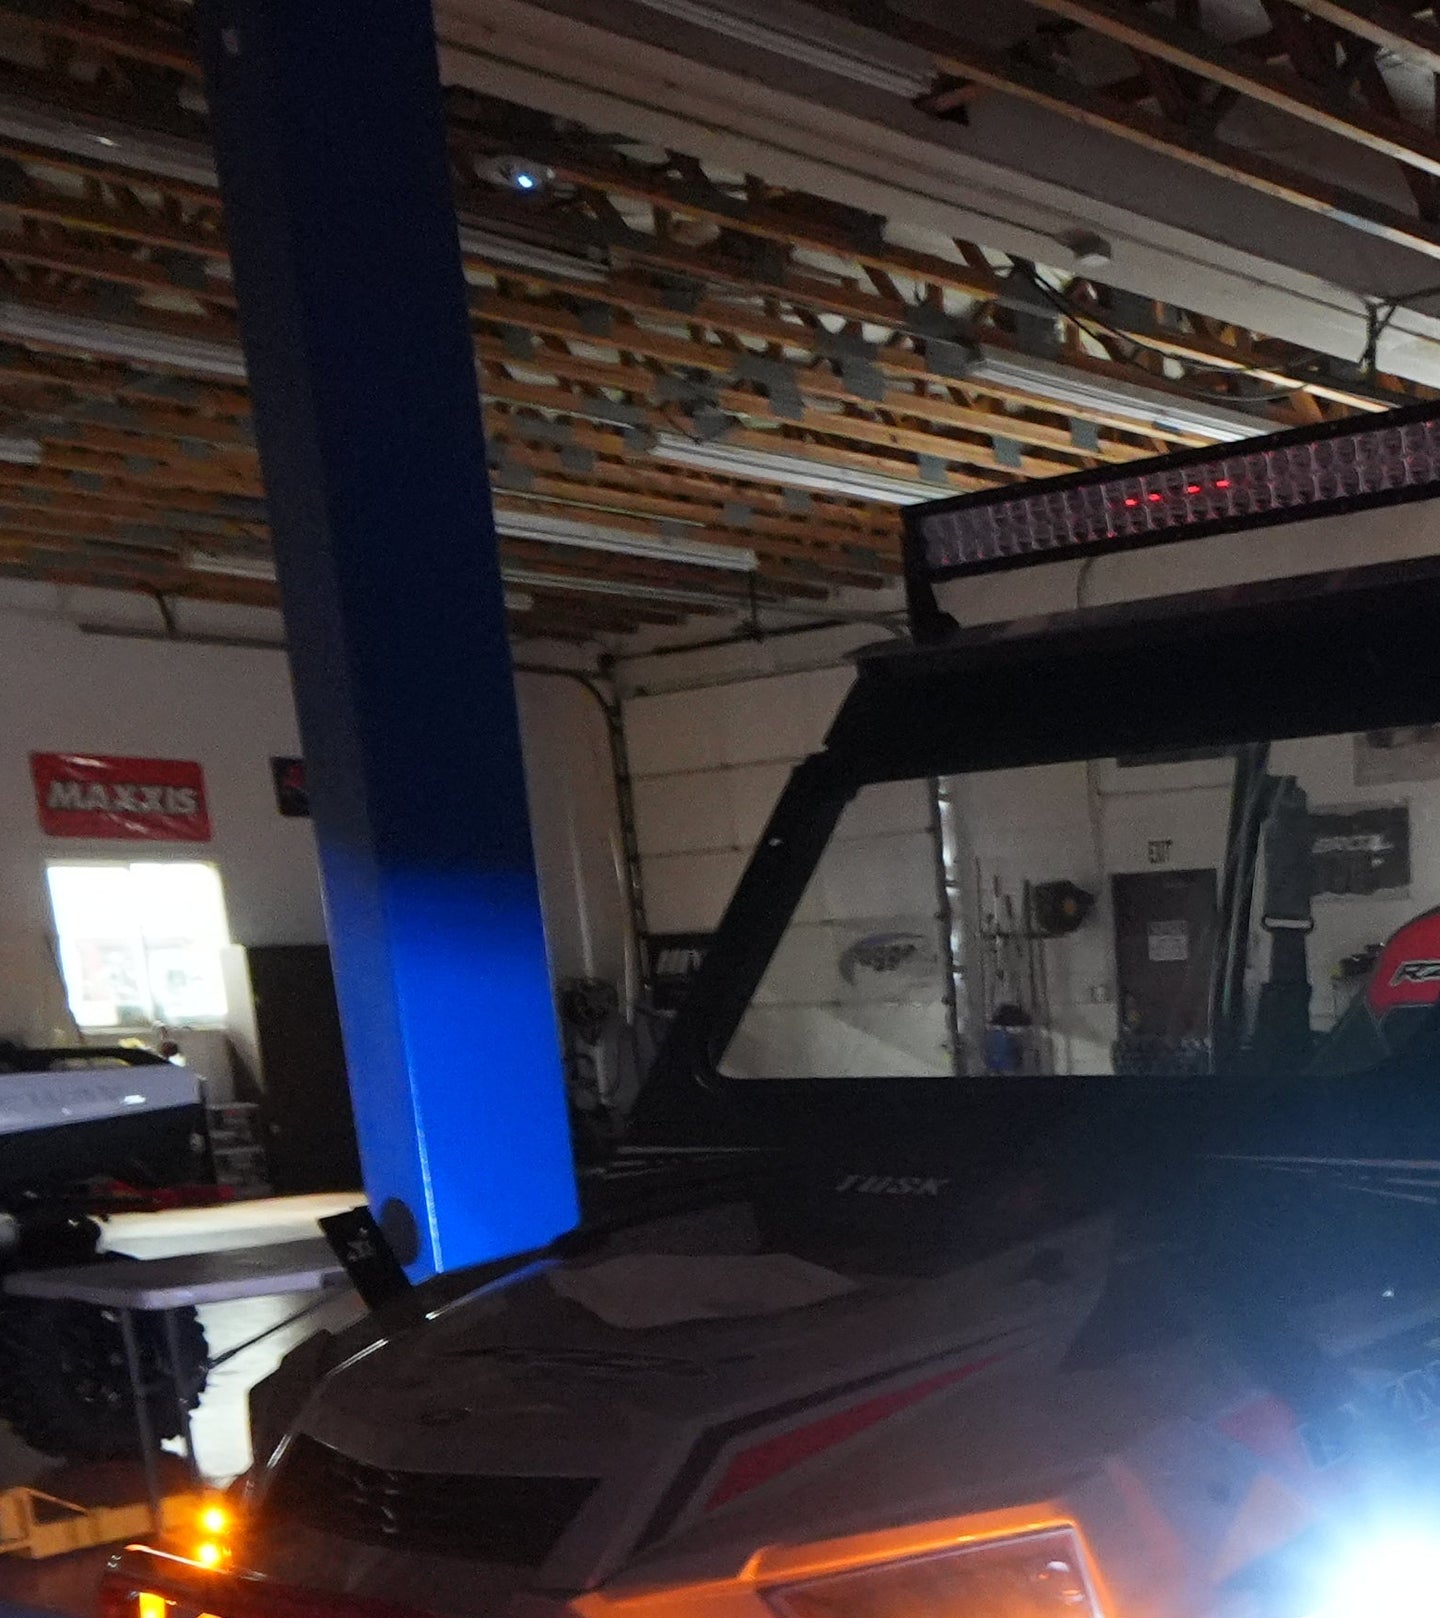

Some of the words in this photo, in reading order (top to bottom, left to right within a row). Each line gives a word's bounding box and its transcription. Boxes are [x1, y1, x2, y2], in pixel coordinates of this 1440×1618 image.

[46, 778, 199, 815] MAXXIS
[1147, 840, 1173, 863] EXIT
[834, 1173, 950, 1197] TUSK
